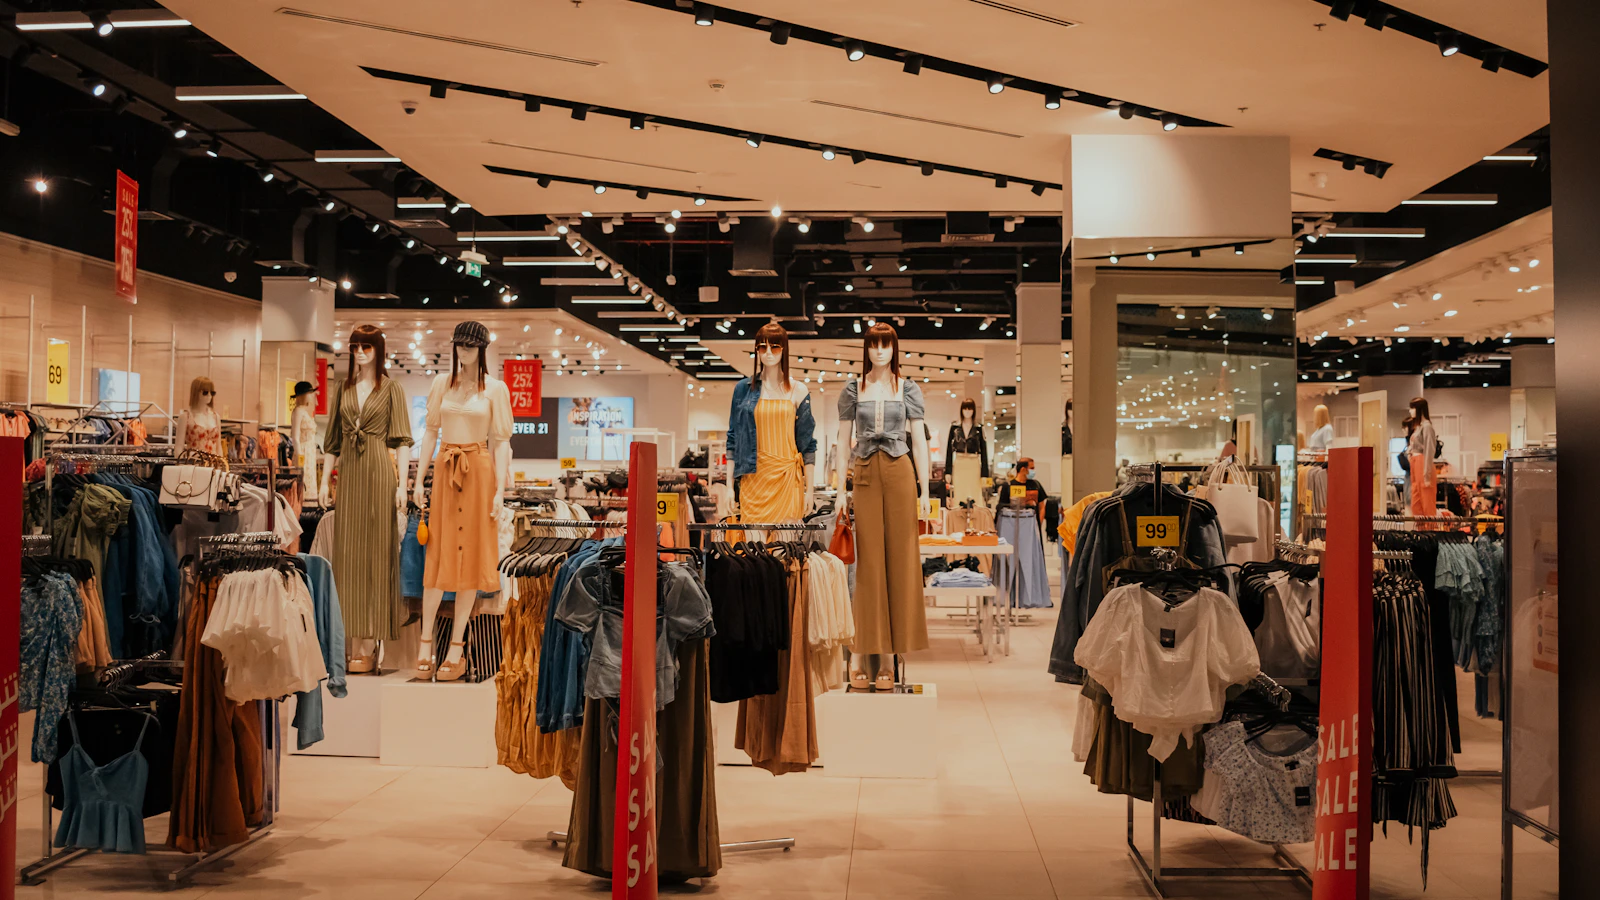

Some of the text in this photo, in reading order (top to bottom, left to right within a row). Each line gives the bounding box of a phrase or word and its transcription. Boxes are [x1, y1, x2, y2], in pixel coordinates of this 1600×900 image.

[48, 364, 62, 385] 69
[512, 373, 533, 388] 25%
[511, 391, 533, 408] 75%
[570, 410, 622, 422] INSPIRATION
[512, 422, 549, 435] EVER 21
[1491, 443, 1502, 451] 59
[563, 459, 573, 467] 59
[657, 500, 667, 515] 9
[1145, 523, 1167, 539] 99
[1317, 713, 1358, 765] SALE
[628, 775, 655, 832] SA
[1314, 828, 1357, 872] ALE
[627, 830, 655, 888] SA
